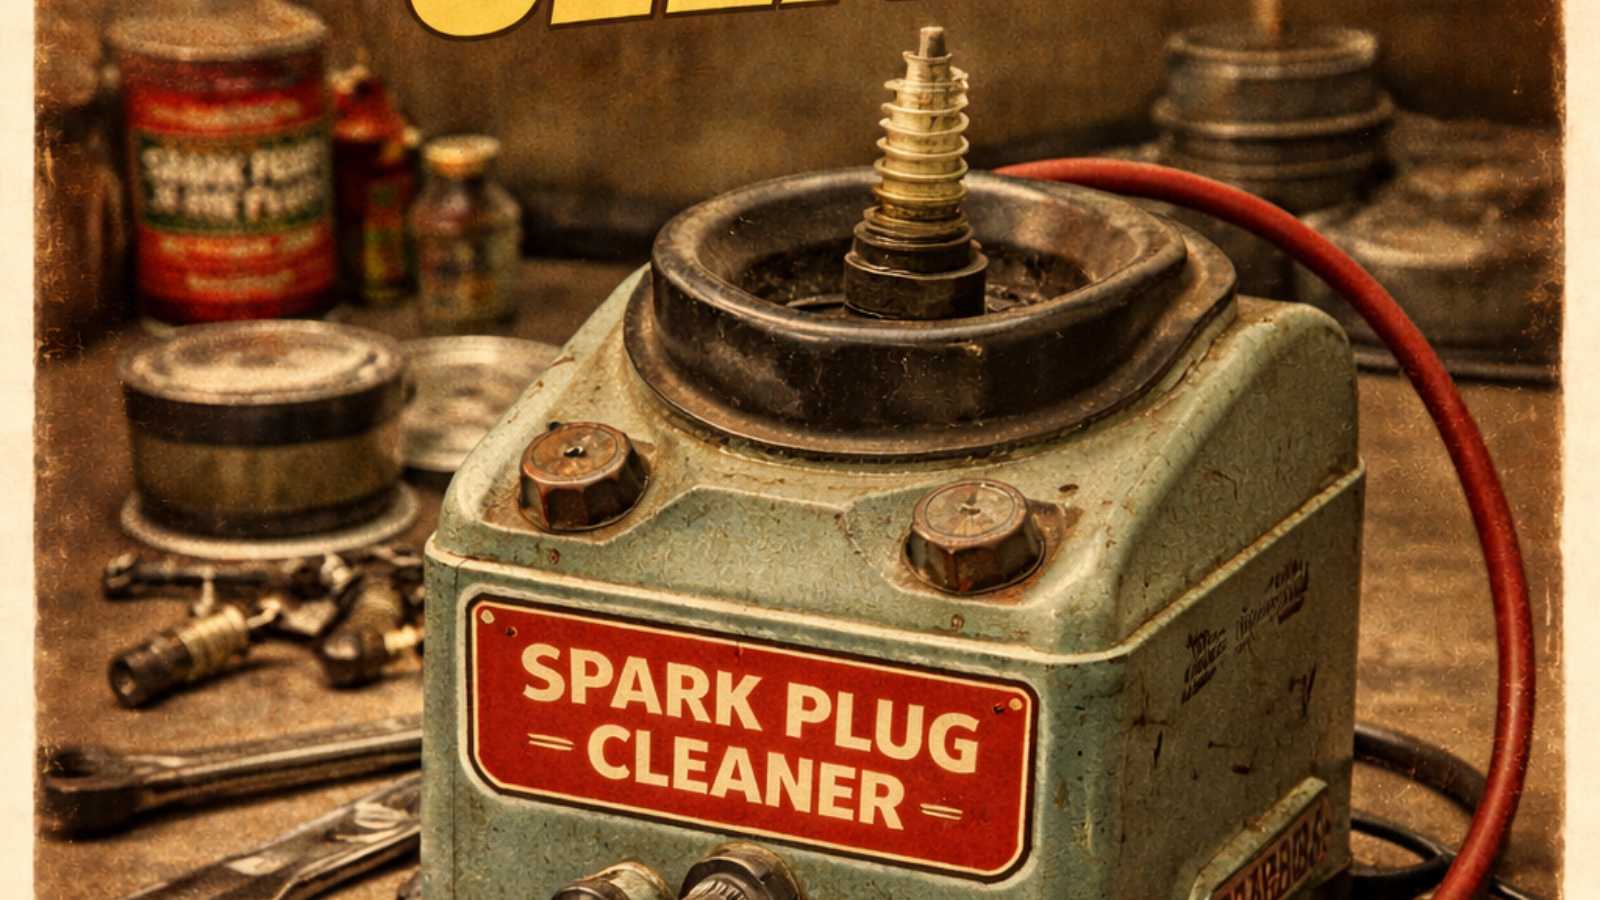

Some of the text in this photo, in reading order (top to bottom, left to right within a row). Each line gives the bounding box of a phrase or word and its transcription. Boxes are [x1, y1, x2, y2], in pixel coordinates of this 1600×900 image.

[521, 642, 980, 774] SPARK PLUG
[586, 724, 905, 830] CLEANER
